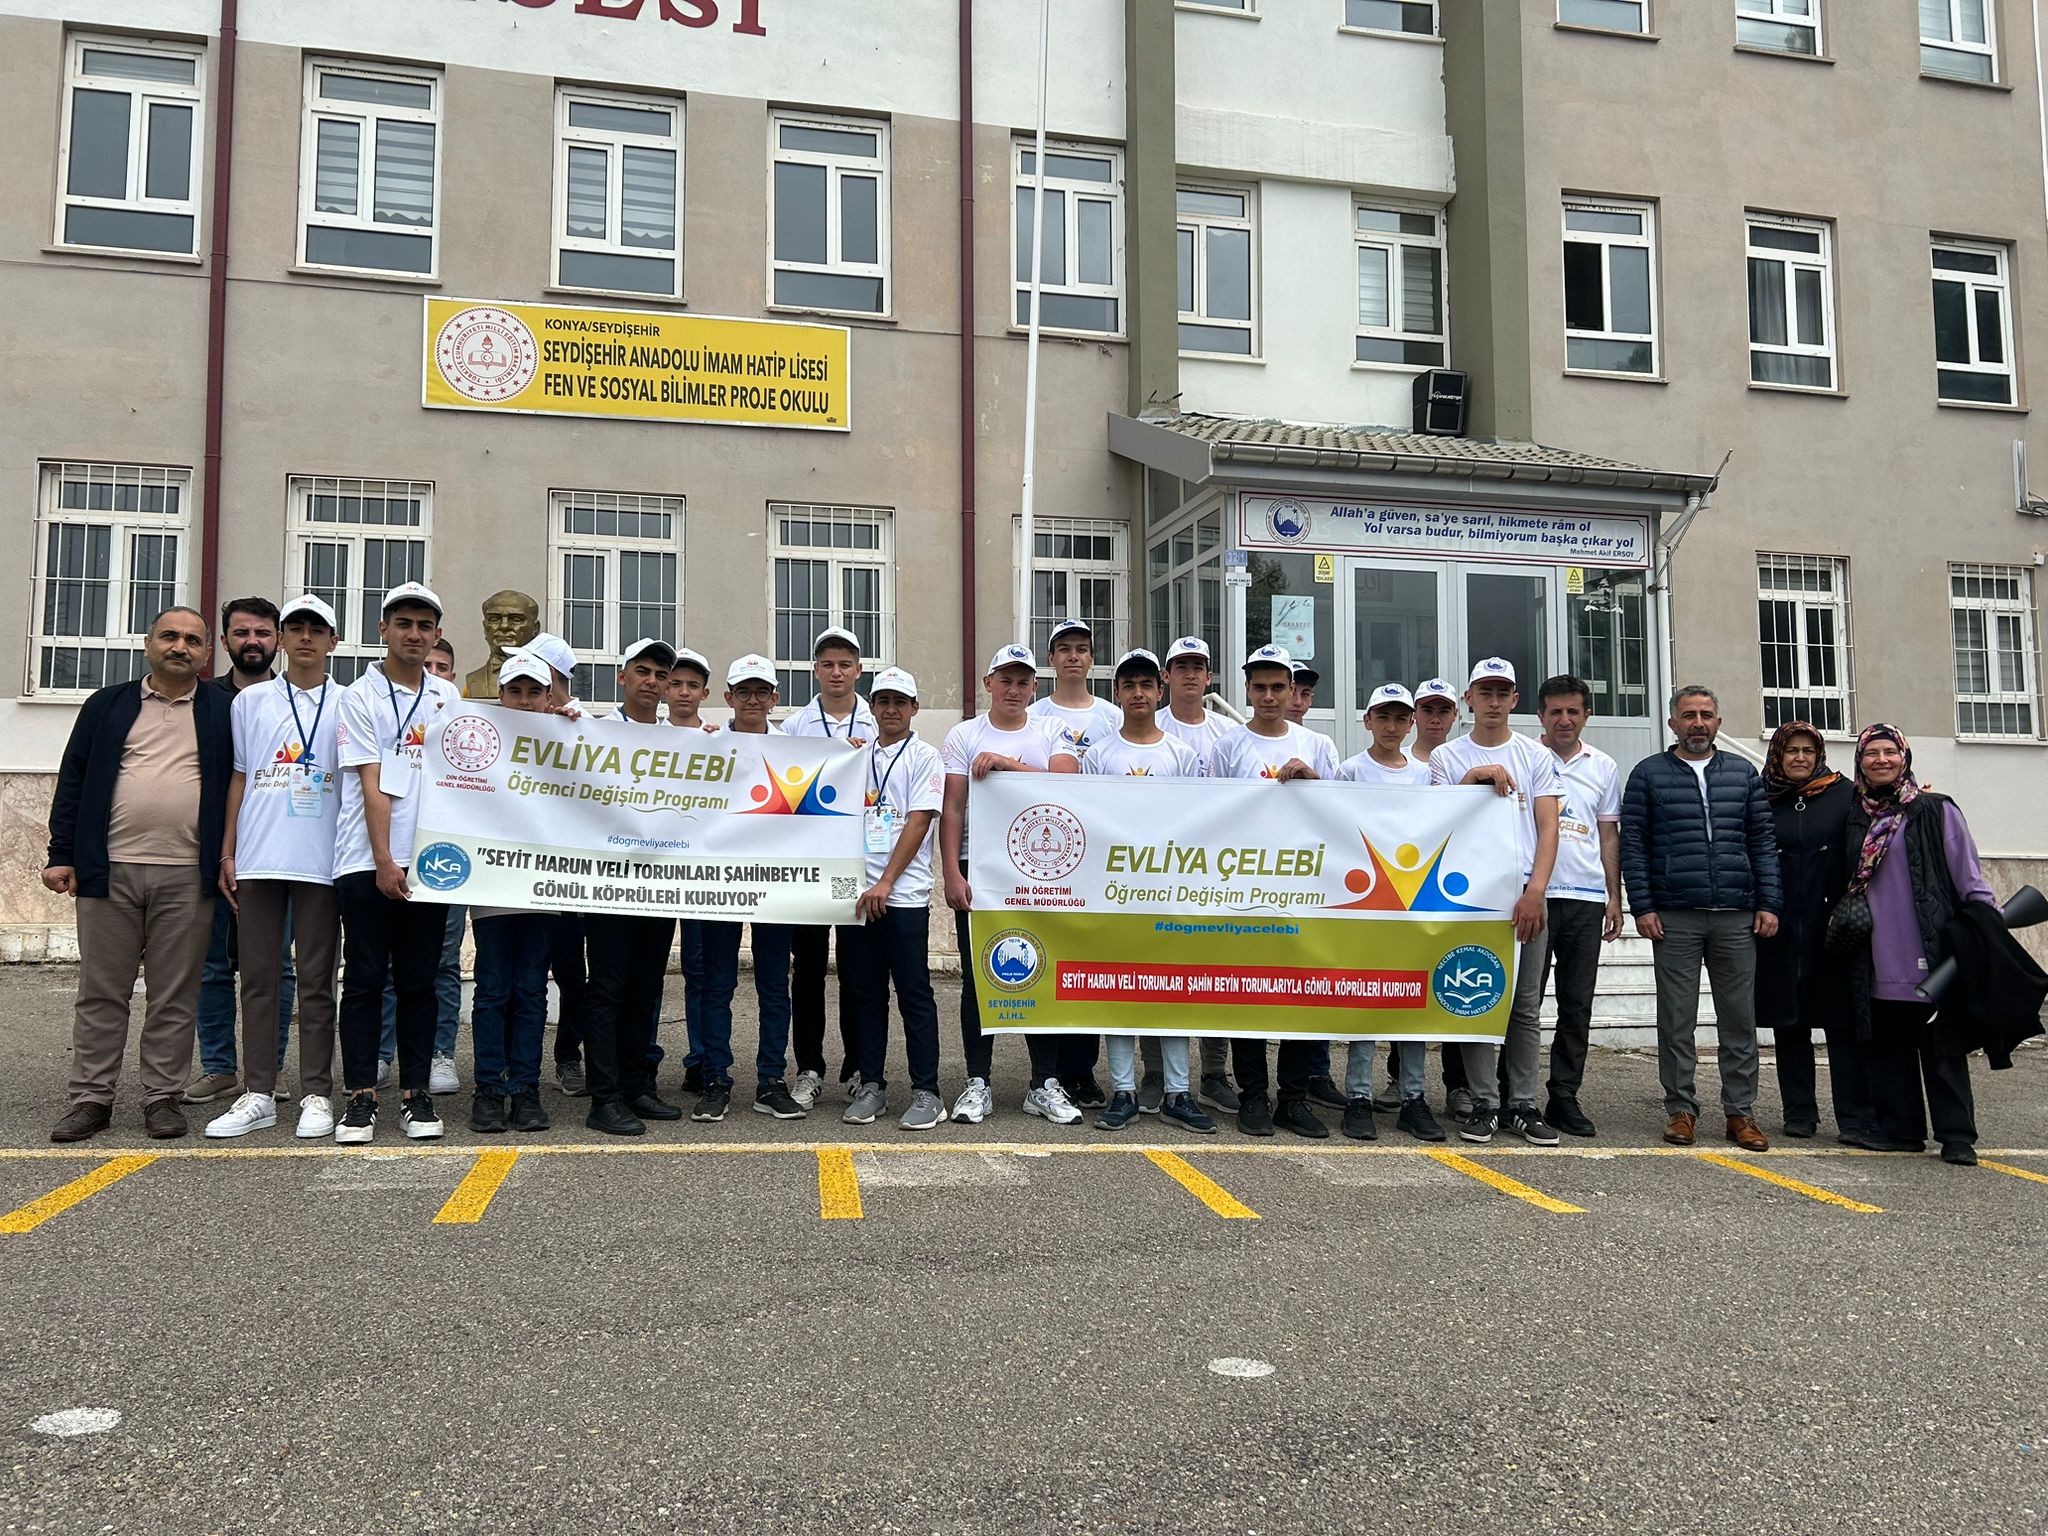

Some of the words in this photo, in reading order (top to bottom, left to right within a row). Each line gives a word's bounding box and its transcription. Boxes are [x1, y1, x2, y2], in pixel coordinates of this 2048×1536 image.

[545, 318, 660, 338] KONYA/SEYDİŞEHİR
[543, 336, 627, 371] SEYDİŞEHİR
[629, 346, 700, 372] ANADOLU
[703, 345, 743, 375] İMAM
[747, 350, 786, 378] HATİP
[789, 352, 828, 382] LİSESİ
[544, 373, 573, 397] FEN
[577, 375, 596, 398] VE
[600, 376, 657, 402] SOSYAL
[661, 374, 727, 407] BİLİMLER
[730, 385, 776, 411] PROJE
[780, 388, 829, 414] OKULU
[1330, 506, 1375, 519] Allah'a
[1378, 509, 1421, 524] güven,
[1424, 512, 1458, 526] sa'ye
[1462, 515, 1494, 528] sarıl,
[1498, 516, 1548, 529] hikmete
[1552, 518, 1575, 531] râm
[1579, 521, 1591, 532] ol
[1364, 522, 1382, 534] Yol
[1386, 525, 1422, 536] varsa
[1425, 526, 1464, 539] budur,
[1468, 528, 1537, 543] bilmiyorum
[1541, 531, 1578, 547] başka
[1582, 535, 1613, 548] çıkar
[1616, 537, 1634, 549] yol
[1570, 548, 1597, 556] Mehmet
[1598, 549, 1612, 557] Akif
[1613, 550, 1634, 558] ERSOY
[510, 734, 621, 774] EVLİYA
[629, 748, 737, 784] ÇELEBİ
[507, 770, 576, 797] Öğrenci
[579, 783, 649, 807] Değişim
[653, 789, 729, 811] Programı
[607, 835, 690, 849] #dogmevliyacelebi
[534, 854, 592, 875] HARUN
[596, 859, 629, 879] VELİ
[633, 863, 721, 881] TORUNLARI
[724, 863, 820, 883] ŞAHİNBEY'LE
[1105, 839, 1208, 875] EVLİYA
[1216, 843, 1326, 882] ÇELEBİ
[533, 879, 588, 900] GÖNÜL
[592, 884, 680, 905] KÖPRÜLERİ
[1005, 897, 1031, 906] GENEL
[1034, 897, 1086, 907] MÜDÜRLÜĞÜ
[1015, 885, 1030, 895] DİN
[1032, 885, 1072, 896] ÖĞRETİMİ
[1105, 880, 1172, 905] Öğrenci
[1176, 886, 1244, 907] Değişim
[1250, 887, 1326, 909] Programı
[1154, 921, 1300, 936] #dogmevliyacelebi
[1062, 969, 1086, 989] SEYİT
[1087, 973, 1116, 990] HARUN
[1117, 971, 1136, 990] VELİ
[1137, 974, 1184, 991] TORUNLARI
[1187, 973, 1213, 995] ŞAHİN
[1214, 973, 1239, 993] BEYİN
[1241, 977, 1302, 994] TORUNLARIYLA
[1304, 976, 1333, 996] GÖNÜL
[1334, 977, 1381, 997] KÖPRÜLERİ
[1382, 981, 1422, 997] KURUYOR
[988, 997, 1036, 1009] SEYDİŞEHİR
